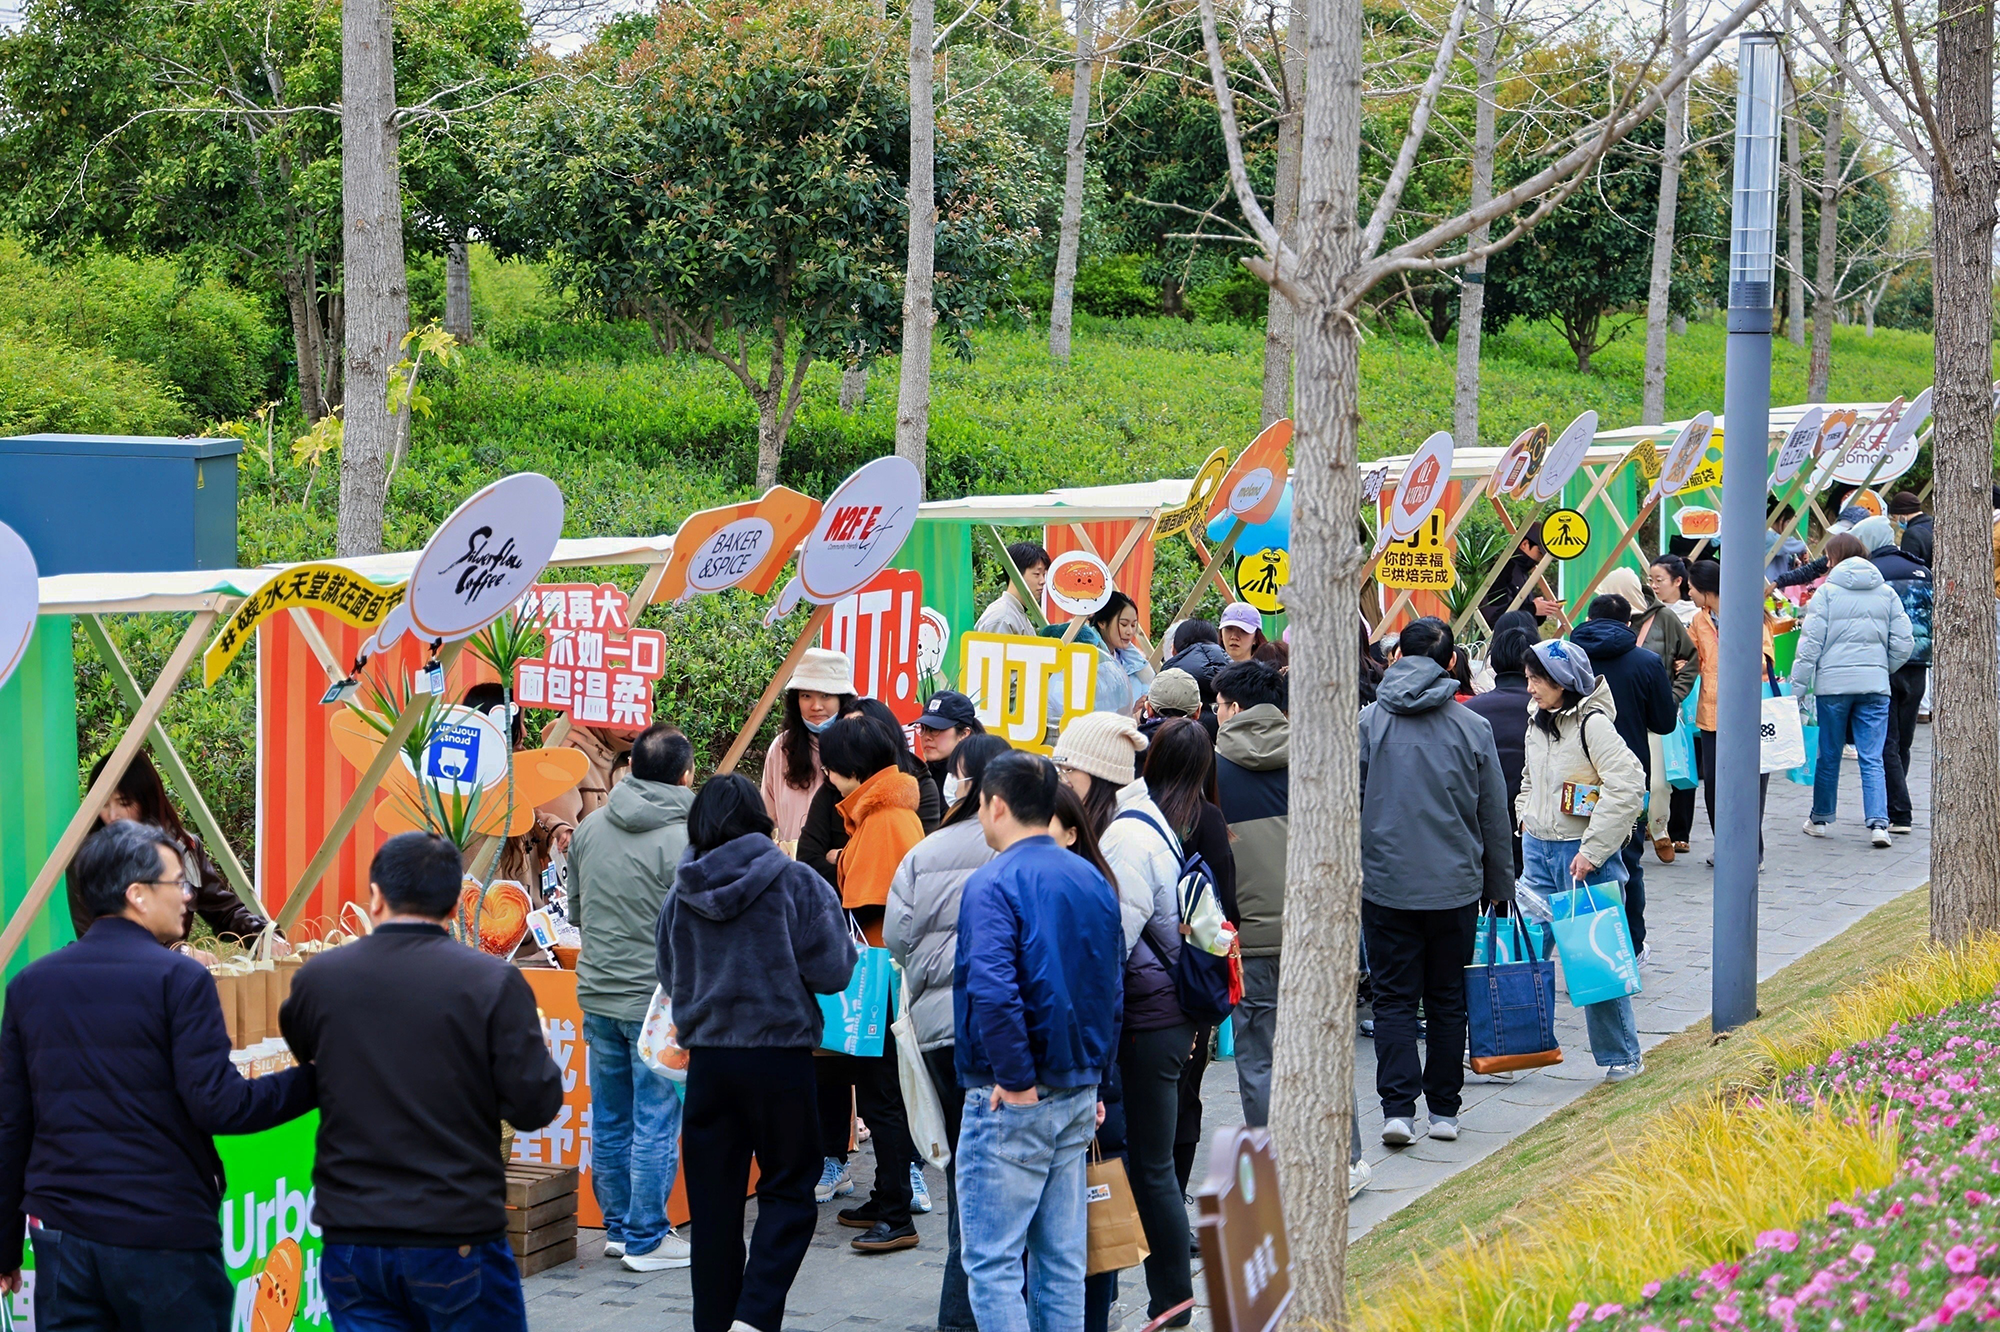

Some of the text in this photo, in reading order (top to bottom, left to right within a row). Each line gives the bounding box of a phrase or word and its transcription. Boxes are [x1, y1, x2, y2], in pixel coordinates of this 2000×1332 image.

[711, 529, 763, 554] BAKER
[1383, 552, 1444, 568] 你的幸福
[455, 565, 506, 605] Coffee
[698, 553, 752, 579] &SPICE
[1382, 567, 1449, 584] 已烘焙完成
[514, 590, 623, 629] 世界再大
[549, 628, 660, 674] 不如一口
[519, 664, 647, 726] 面包温柔
[1613, 921, 1631, 960] Cultural
